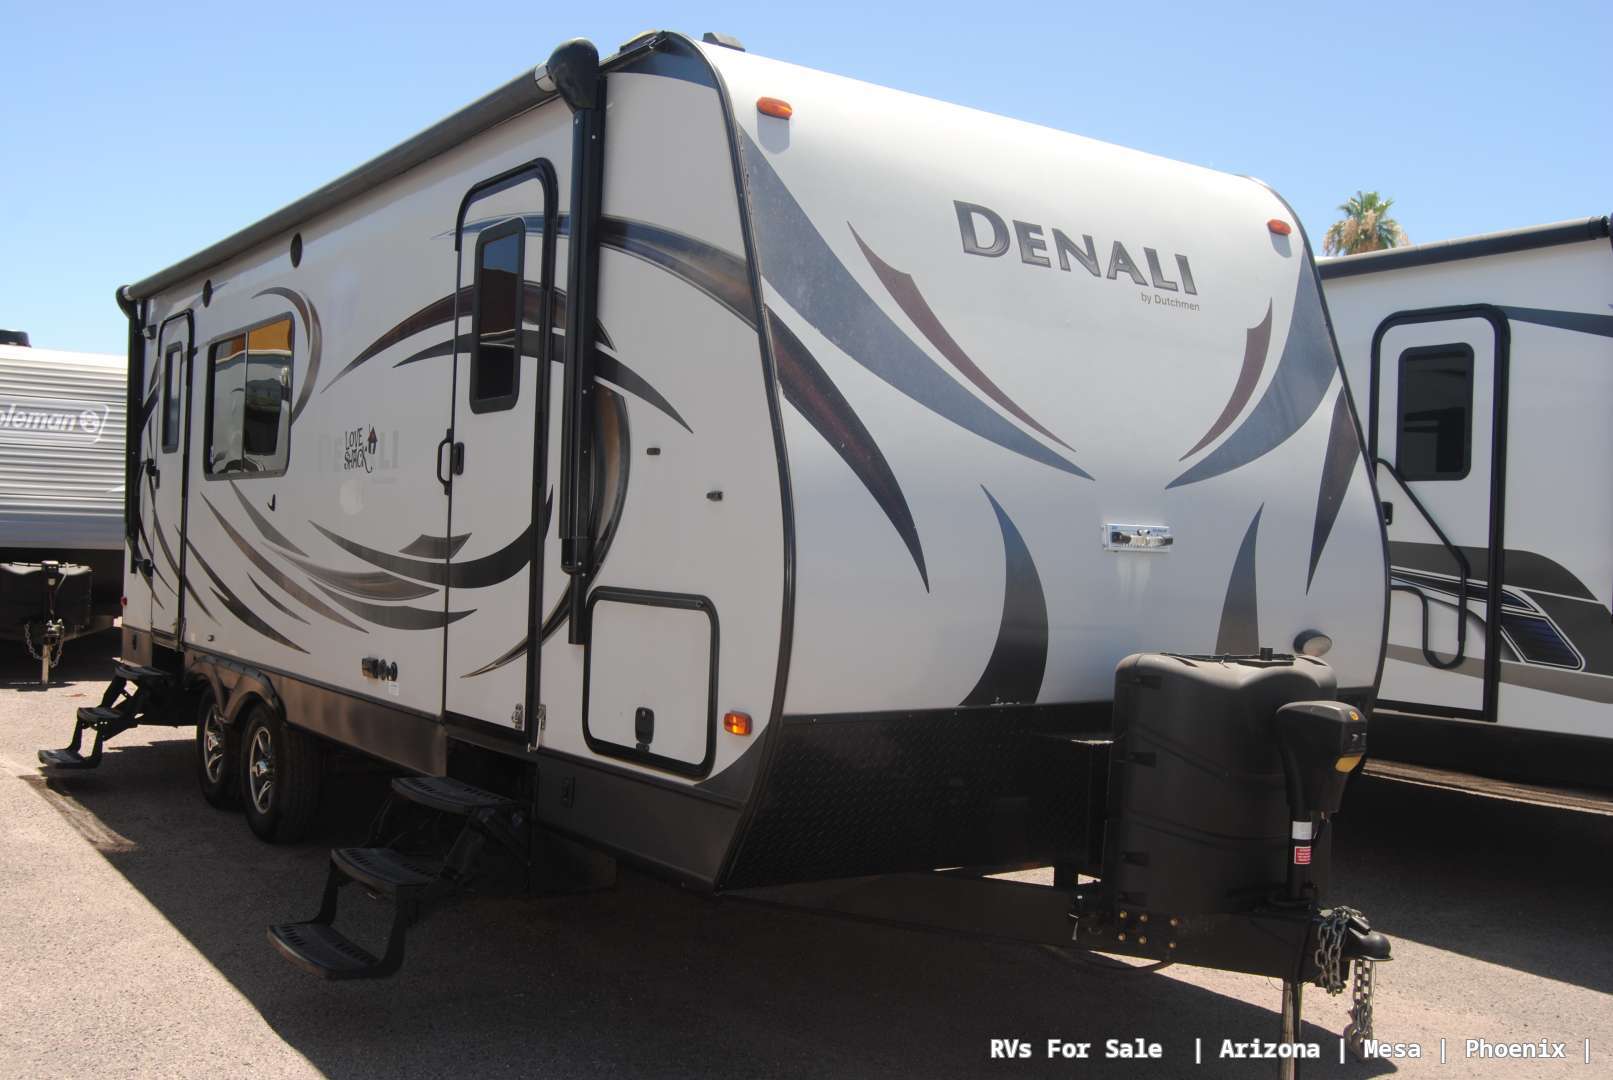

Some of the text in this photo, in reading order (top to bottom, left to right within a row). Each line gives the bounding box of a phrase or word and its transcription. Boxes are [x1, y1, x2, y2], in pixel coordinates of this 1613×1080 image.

[953, 199, 1198, 296] DENALI
[1140, 291, 1201, 312] by Dutchmen
[344, 427, 364, 450] LOVE
